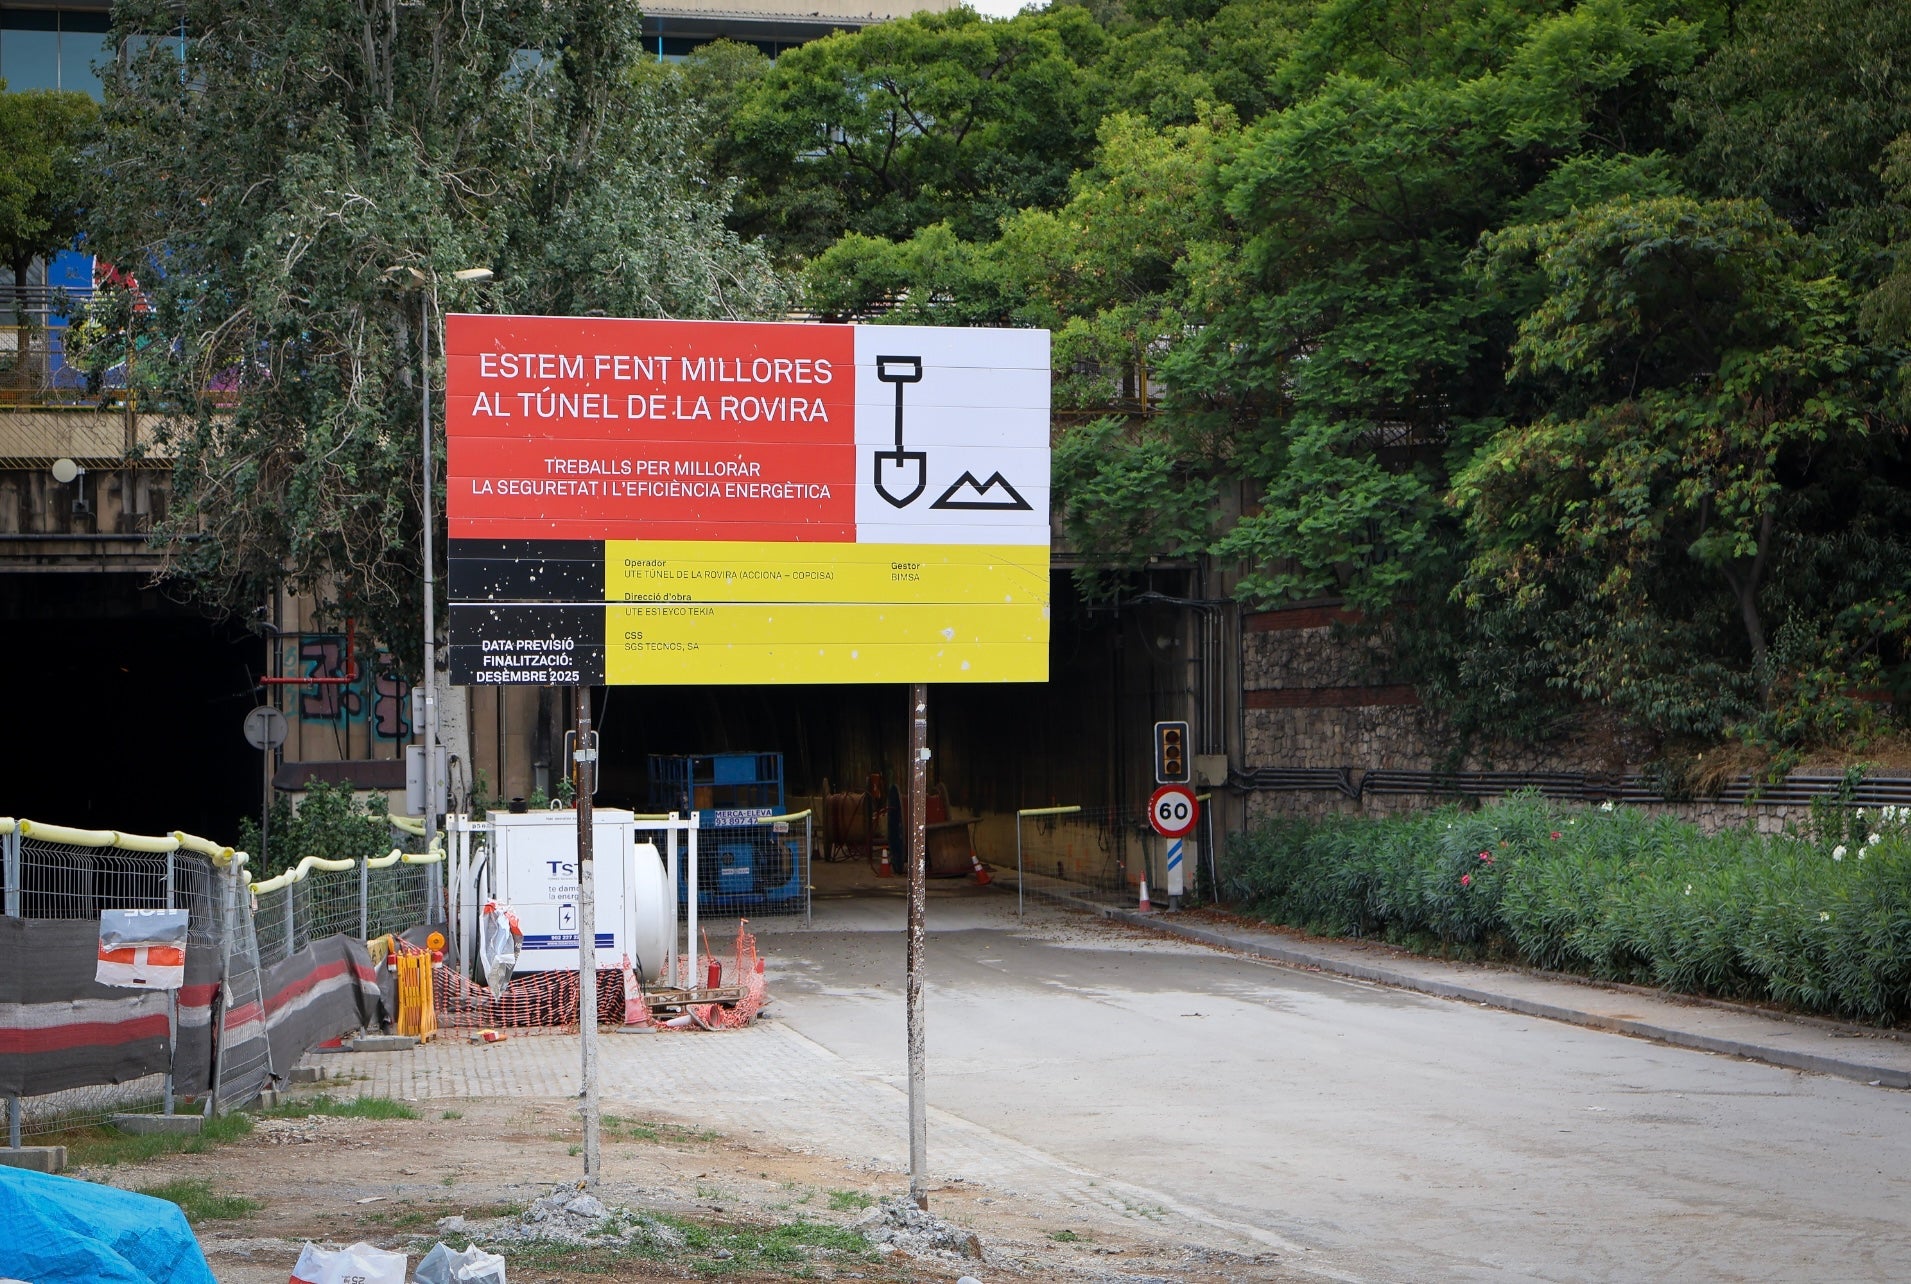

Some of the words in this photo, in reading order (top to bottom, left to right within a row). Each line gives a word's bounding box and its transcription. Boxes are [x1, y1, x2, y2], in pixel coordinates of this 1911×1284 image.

[480, 353, 584, 379] ESTEM
[594, 355, 672, 381] FENT
[681, 356, 833, 384] MILLORES
[472, 391, 511, 417] AL
[517, 386, 619, 418] TÚNEL
[627, 394, 667, 419] DE
[676, 395, 712, 420] LA
[720, 396, 829, 422] ROVIRA
[544, 458, 632, 475] TREBALLS
[636, 460, 670, 475] PER
[674, 461, 761, 477] MILLORAR
[472, 480, 493, 494] LA
[497, 479, 598, 496] SEGURETAT
[603, 481, 607, 496] I
[612, 479, 721, 497] L'EFICIÈNCIA
[725, 481, 831, 499] ENERGÈTICA
[624, 559, 667, 568] Operador
[891, 562, 921, 570] Gestor
[624, 570, 641, 578] UTE
[644, 568, 675, 579] TÚNEL
[676, 571, 689, 579] DE
[691, 571, 703, 579] LA
[704, 571, 738, 579] ROVIRA
[740, 571, 782, 580] (ACCIONA
[792, 571, 834, 580] COPCISA)
[891, 573, 920, 581] BIMSA
[624, 592, 661, 601] Direcció
[663, 592, 692, 601] d'obra
[625, 608, 643, 616] UTE
[645, 608, 687, 616] ESTEYCO
[689, 608, 715, 616] TEKIA
[624, 631, 643, 640] CSS
[482, 640, 514, 651] DATA
[516, 637, 574, 650] PREVISIÓ
[624, 642, 643, 650] SGS
[687, 642, 700, 650] SA
[483, 652, 573, 667] FINALITZACIÓ:
[476, 671, 547, 682] DESEMBRE
[549, 671, 580, 681] 2025
[715, 809, 772, 818] MERCA-ELEVA
[1160, 803, 1188, 820] 60
[716, 818, 726, 826] 93
